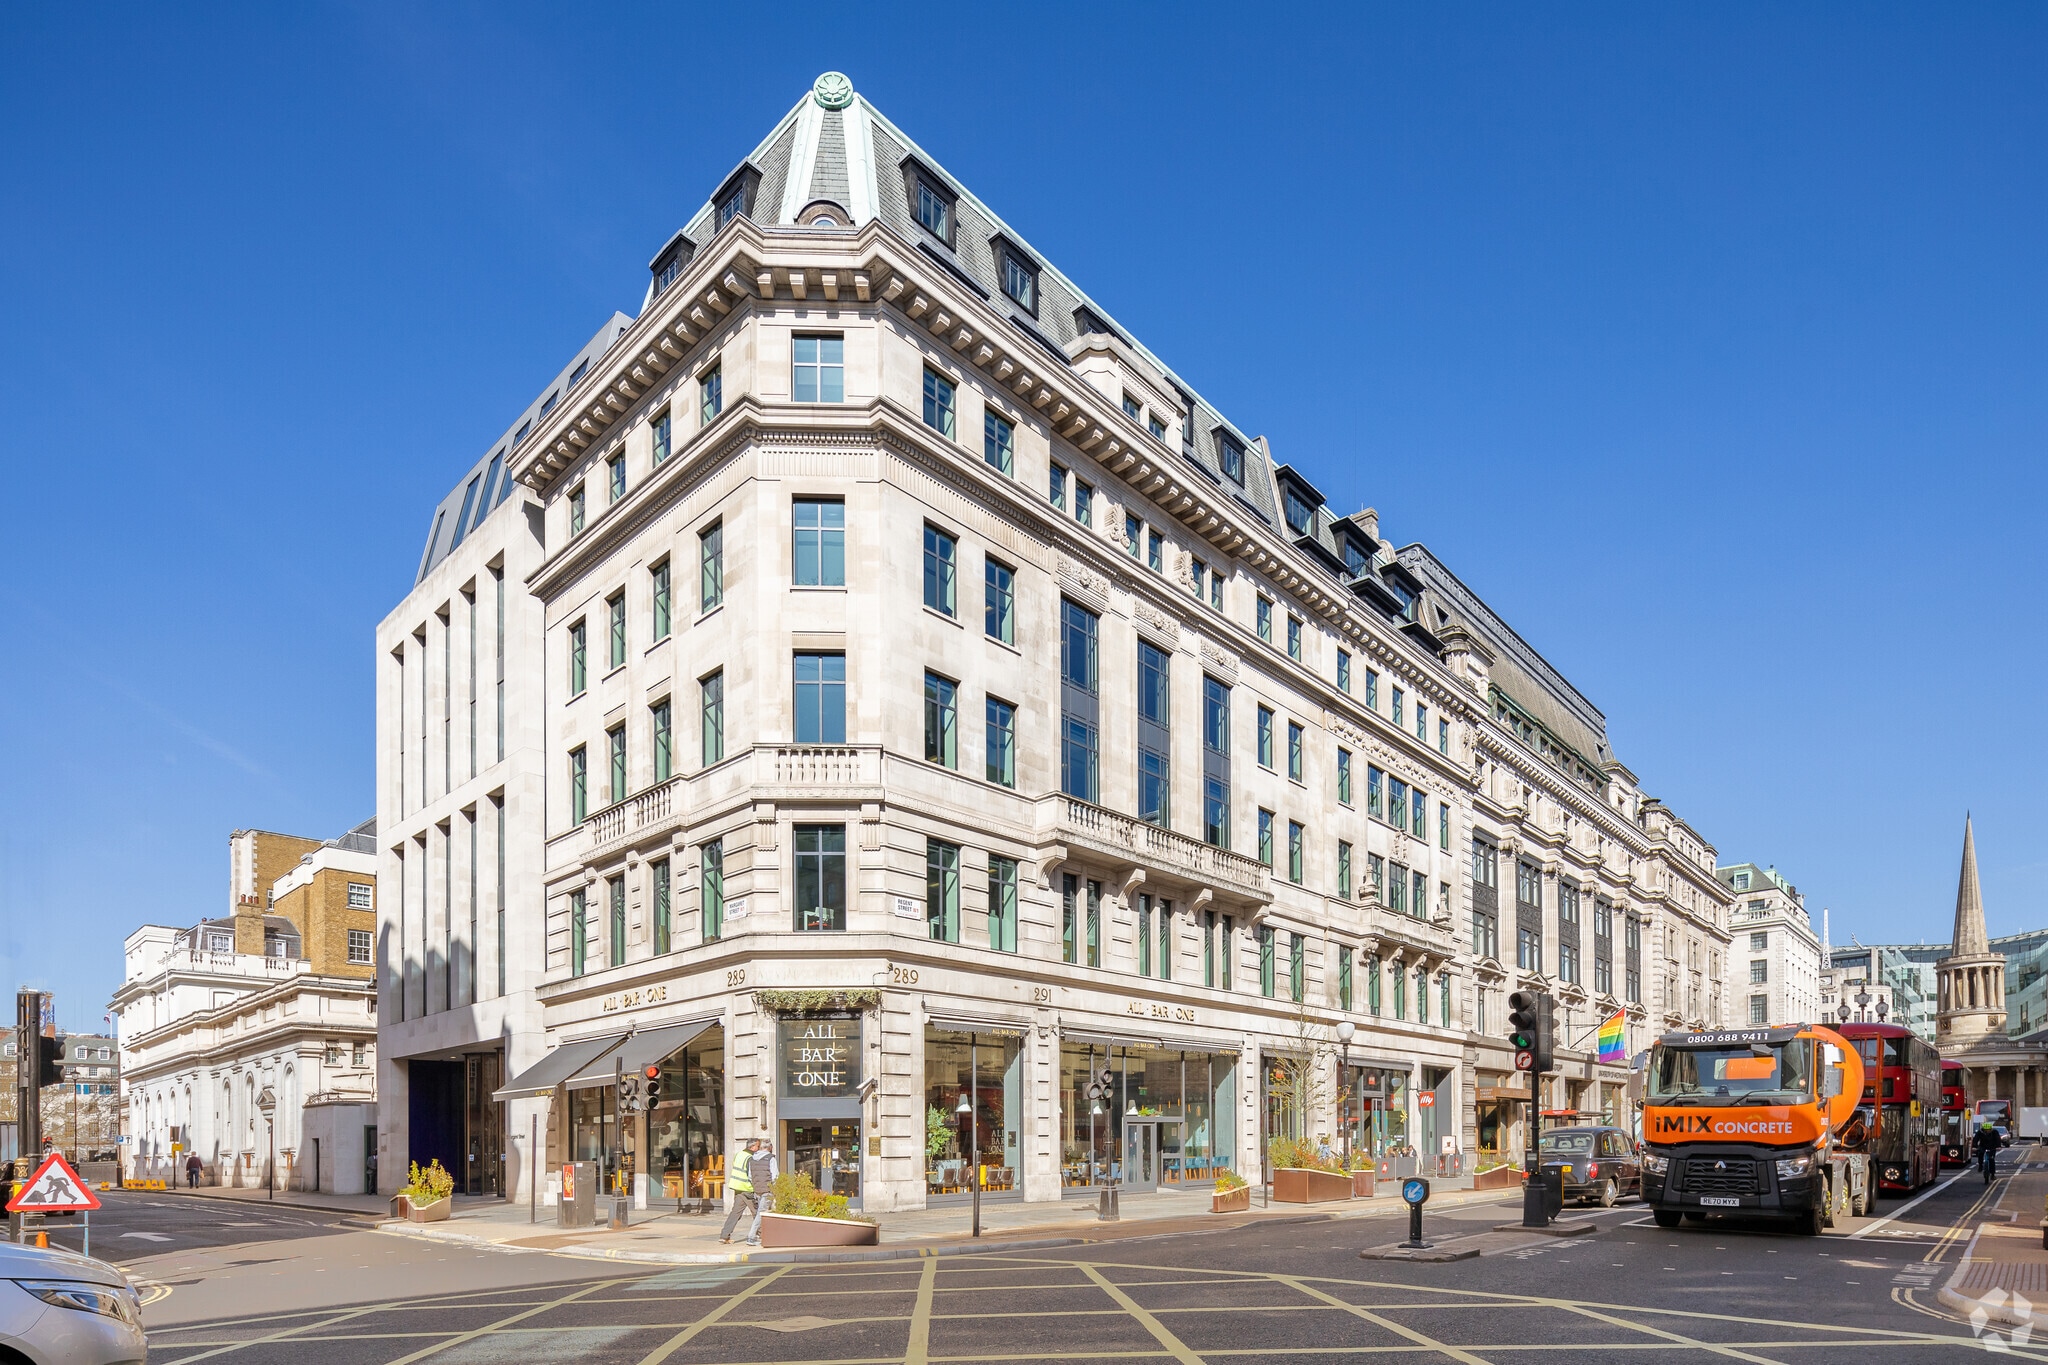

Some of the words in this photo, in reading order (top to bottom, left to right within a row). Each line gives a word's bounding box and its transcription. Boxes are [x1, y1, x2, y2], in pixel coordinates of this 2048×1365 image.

[897, 898, 913, 906] REGENT
[897, 904, 912, 912] STREET
[727, 969, 745, 987] 289
[893, 967, 919, 985] 289
[603, 996, 618, 1012] ALL
[624, 991, 641, 1009] BAR
[647, 986, 667, 1003] ONE
[1034, 987, 1052, 1003] 291
[1127, 1000, 1145, 1015] ALL
[1151, 1004, 1169, 1018] BAR
[1176, 1007, 1195, 1022] ONE
[803, 1024, 837, 1039] ALL
[1687, 1035, 1715, 1044] 0800
[1718, 1033, 1738, 1042] 688
[1741, 1032, 1769, 1041] 9411
[801, 1048, 837, 1062] BAR
[798, 1071, 840, 1087] ONE
[1420, 1095, 1434, 1106] illy
[1655, 1115, 1713, 1133] iMIX
[1714, 1121, 1793, 1134] CONCRETE
